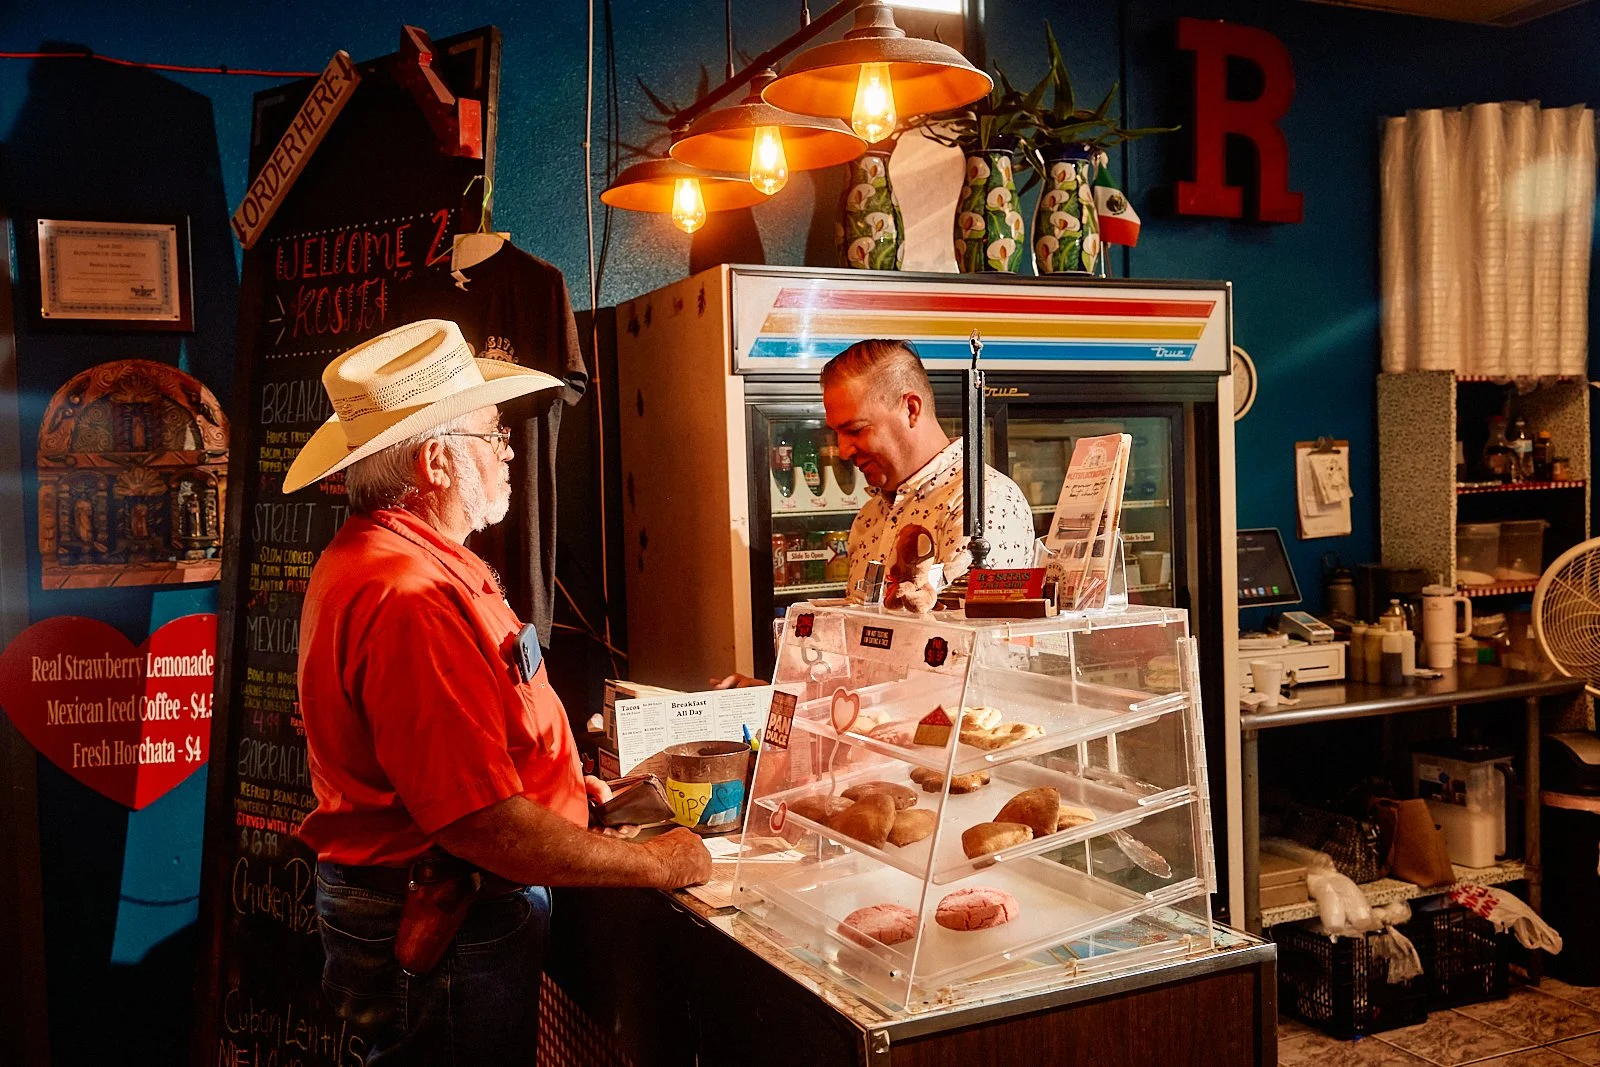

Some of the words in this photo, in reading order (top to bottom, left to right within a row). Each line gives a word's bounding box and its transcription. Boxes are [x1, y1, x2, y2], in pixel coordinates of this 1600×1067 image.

[1178, 16, 1304, 224] R
[242, 133, 303, 229] ORDER
[293, 68, 344, 148] HERE
[276, 224, 413, 281] WELCOME
[252, 503, 317, 543] STREET
[260, 545, 282, 563] SLOW
[283, 549, 315, 564] COOKED
[791, 552, 804, 560] Slide
[811, 552, 824, 560] Open
[31, 652, 62, 682] Real
[65, 651, 144, 683] Strawberry
[147, 648, 215, 678] Lemonade
[46, 696, 104, 726] Mexican
[107, 694, 137, 724] Iced
[139, 692, 182, 722] Coffee
[671, 700, 707, 709] Breakfast
[689, 709, 703, 717] Day
[767, 713, 792, 734] PAN
[765, 729, 788, 746] DULCE
[73, 739, 112, 768] Fresh
[114, 736, 176, 767] Horchata
[185, 734, 202, 764] $4
[240, 781, 271, 800] REFRIED
[236, 812, 266, 830] SERVED
[266, 818, 288, 834] WITH
